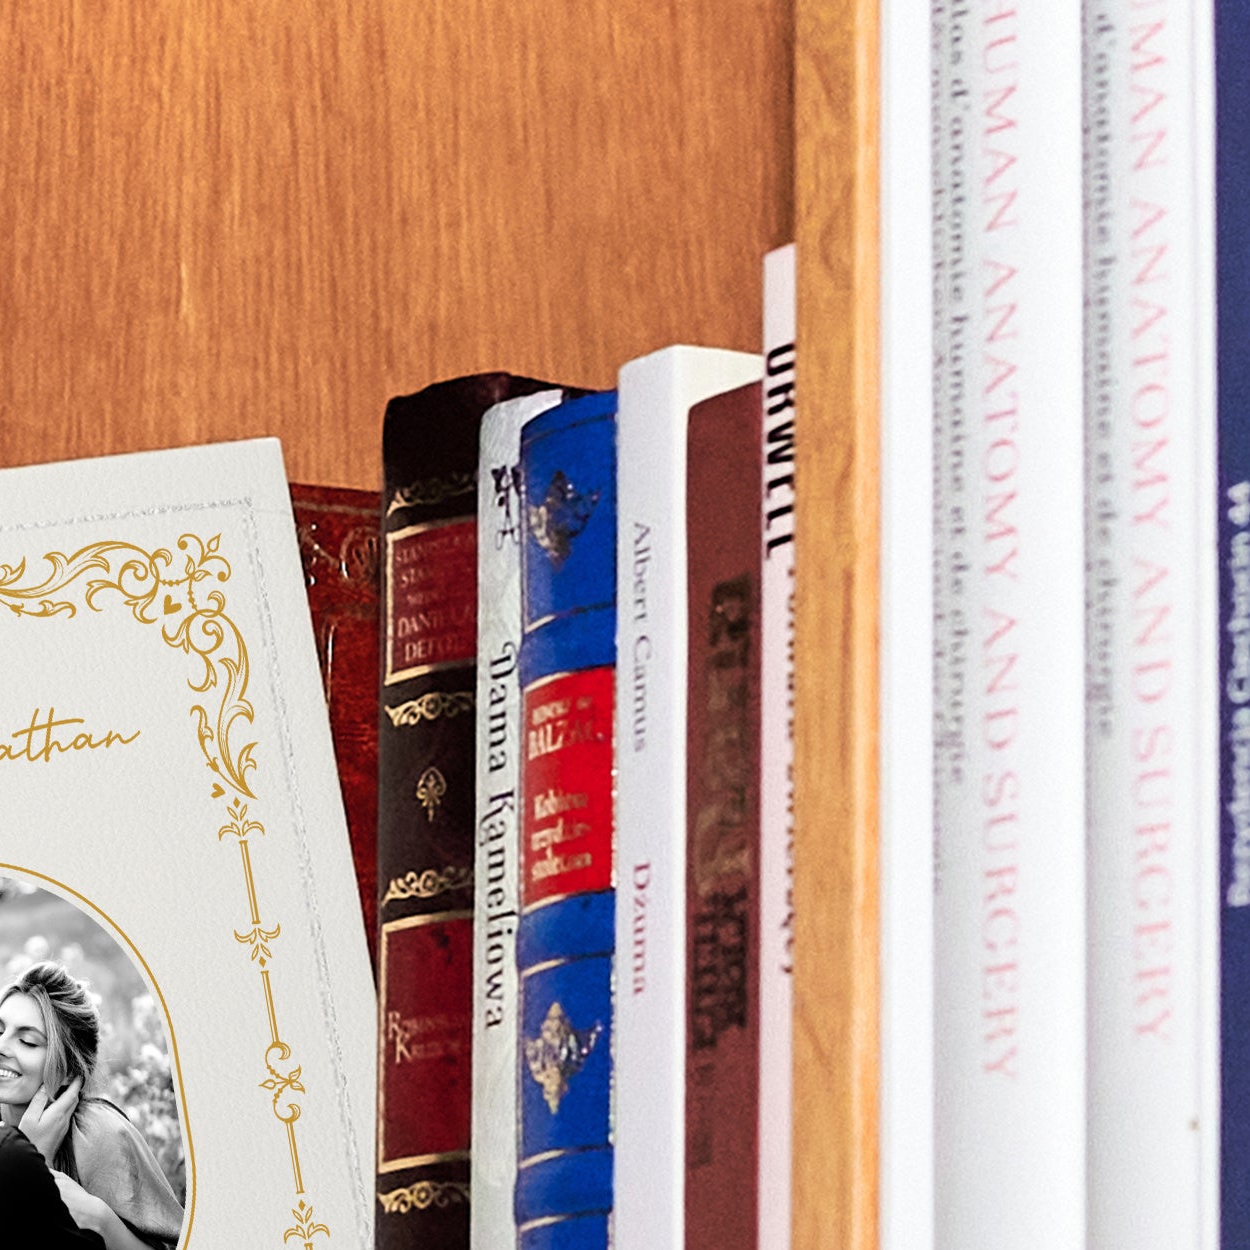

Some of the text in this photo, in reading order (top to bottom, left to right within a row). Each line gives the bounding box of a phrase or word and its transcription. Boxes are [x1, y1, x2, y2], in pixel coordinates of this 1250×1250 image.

[951, 315, 969, 492] humaine
[982, 257, 1018, 581] ANATOMY
[1097, 256, 1117, 439] humaine
[1130, 198, 1172, 528] ANATOMY
[951, 505, 967, 539] et
[1097, 451, 1113, 484] et
[1097, 498, 1117, 546] de
[632, 521, 653, 622] Albert
[951, 551, 970, 595] de
[1132, 556, 1174, 704] AND
[632, 633, 653, 753] Camus
[982, 605, 1018, 752] AND
[479, 641, 517, 1028] Dama Kameliowa
[1132, 724, 1176, 1046] SURGERY
[982, 769, 1018, 1079] SURGERY
